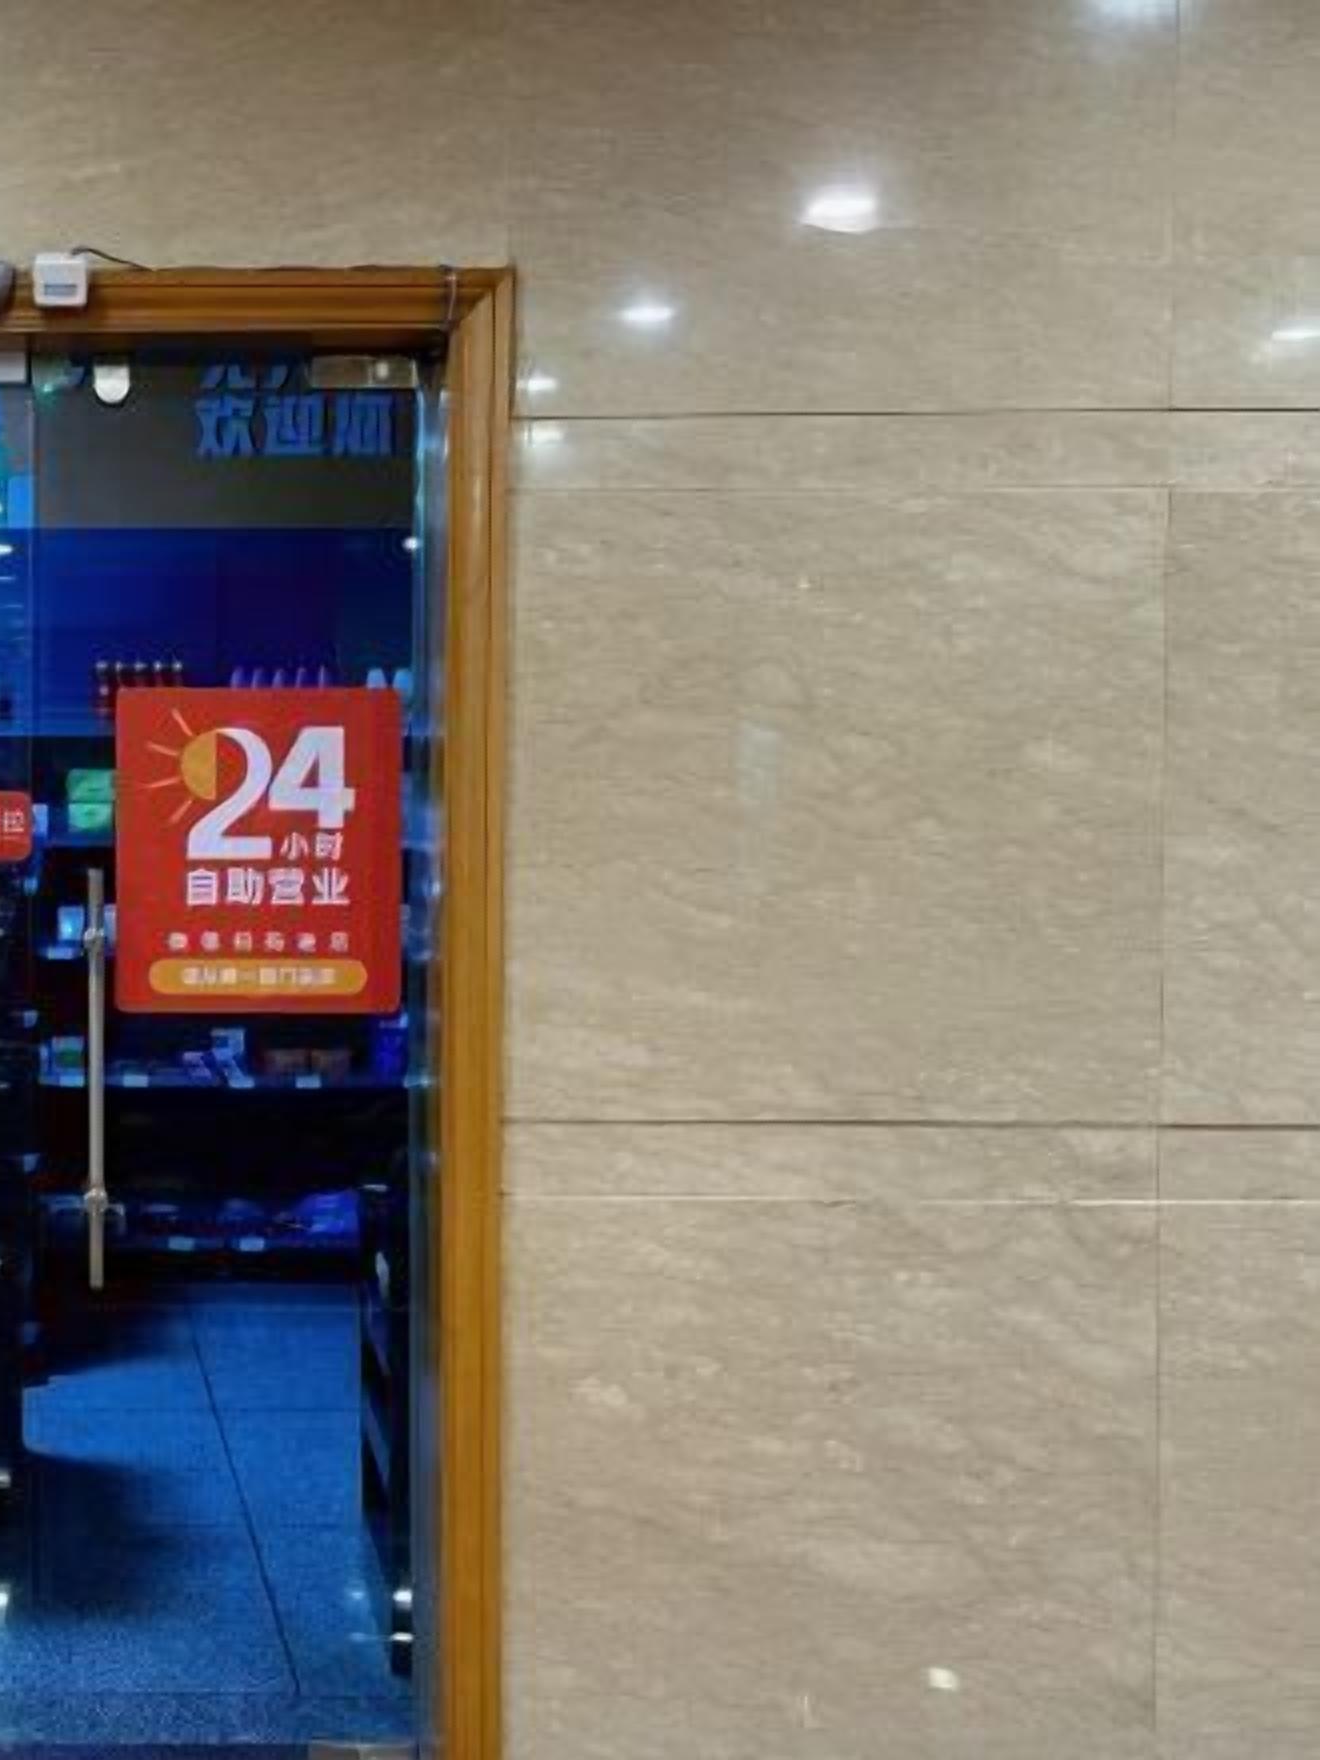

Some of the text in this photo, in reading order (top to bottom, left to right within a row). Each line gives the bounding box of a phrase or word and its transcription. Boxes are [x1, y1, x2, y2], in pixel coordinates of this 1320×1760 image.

[185, 725, 356, 860] 24
[279, 831, 345, 861] 小时
[185, 867, 351, 906] 自助营业
